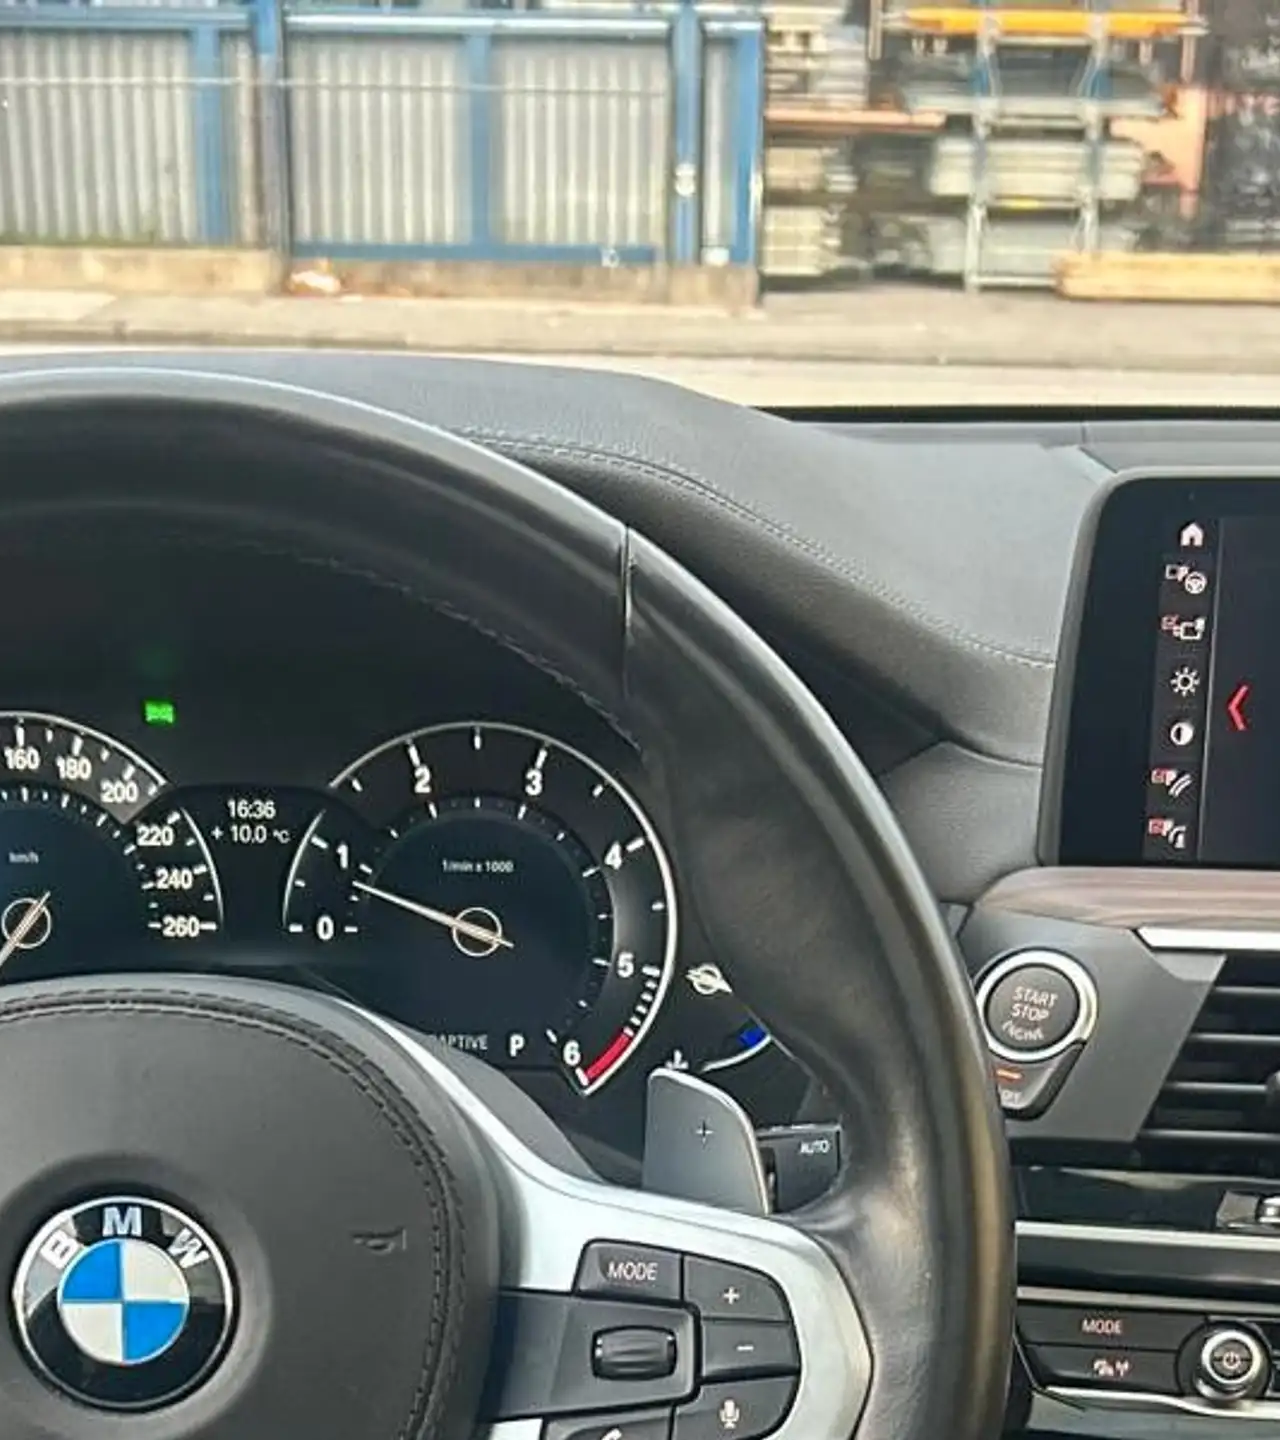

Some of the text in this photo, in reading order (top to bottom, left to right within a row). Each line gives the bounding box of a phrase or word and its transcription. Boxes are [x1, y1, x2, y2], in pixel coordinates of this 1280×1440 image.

[3, 747, 40, 771] 160
[55, 756, 93, 781] 180
[100, 779, 140, 804] 200
[414, 768, 432, 795] 2
[525, 769, 544, 796] 3
[226, 799, 277, 820] 16:36
[135, 823, 176, 848] 220
[230, 824, 267, 844] 10.0
[335, 843, 349, 870] 1
[441, 858, 474, 873] 1/min
[484, 858, 515, 873] 1000
[604, 840, 623, 869] 4
[156, 867, 193, 890] 240
[162, 916, 200, 938] 260
[316, 914, 335, 940] 0
[617, 951, 635, 976] 5
[1011, 986, 1059, 1007] START
[1011, 1003, 1050, 1022] STOP
[509, 1033, 525, 1057] P
[562, 1039, 582, 1067] 6
[39, 1205, 211, 1271] BMW
[607, 1261, 659, 1281] MODE
[1081, 1318, 1122, 1336] MODE
